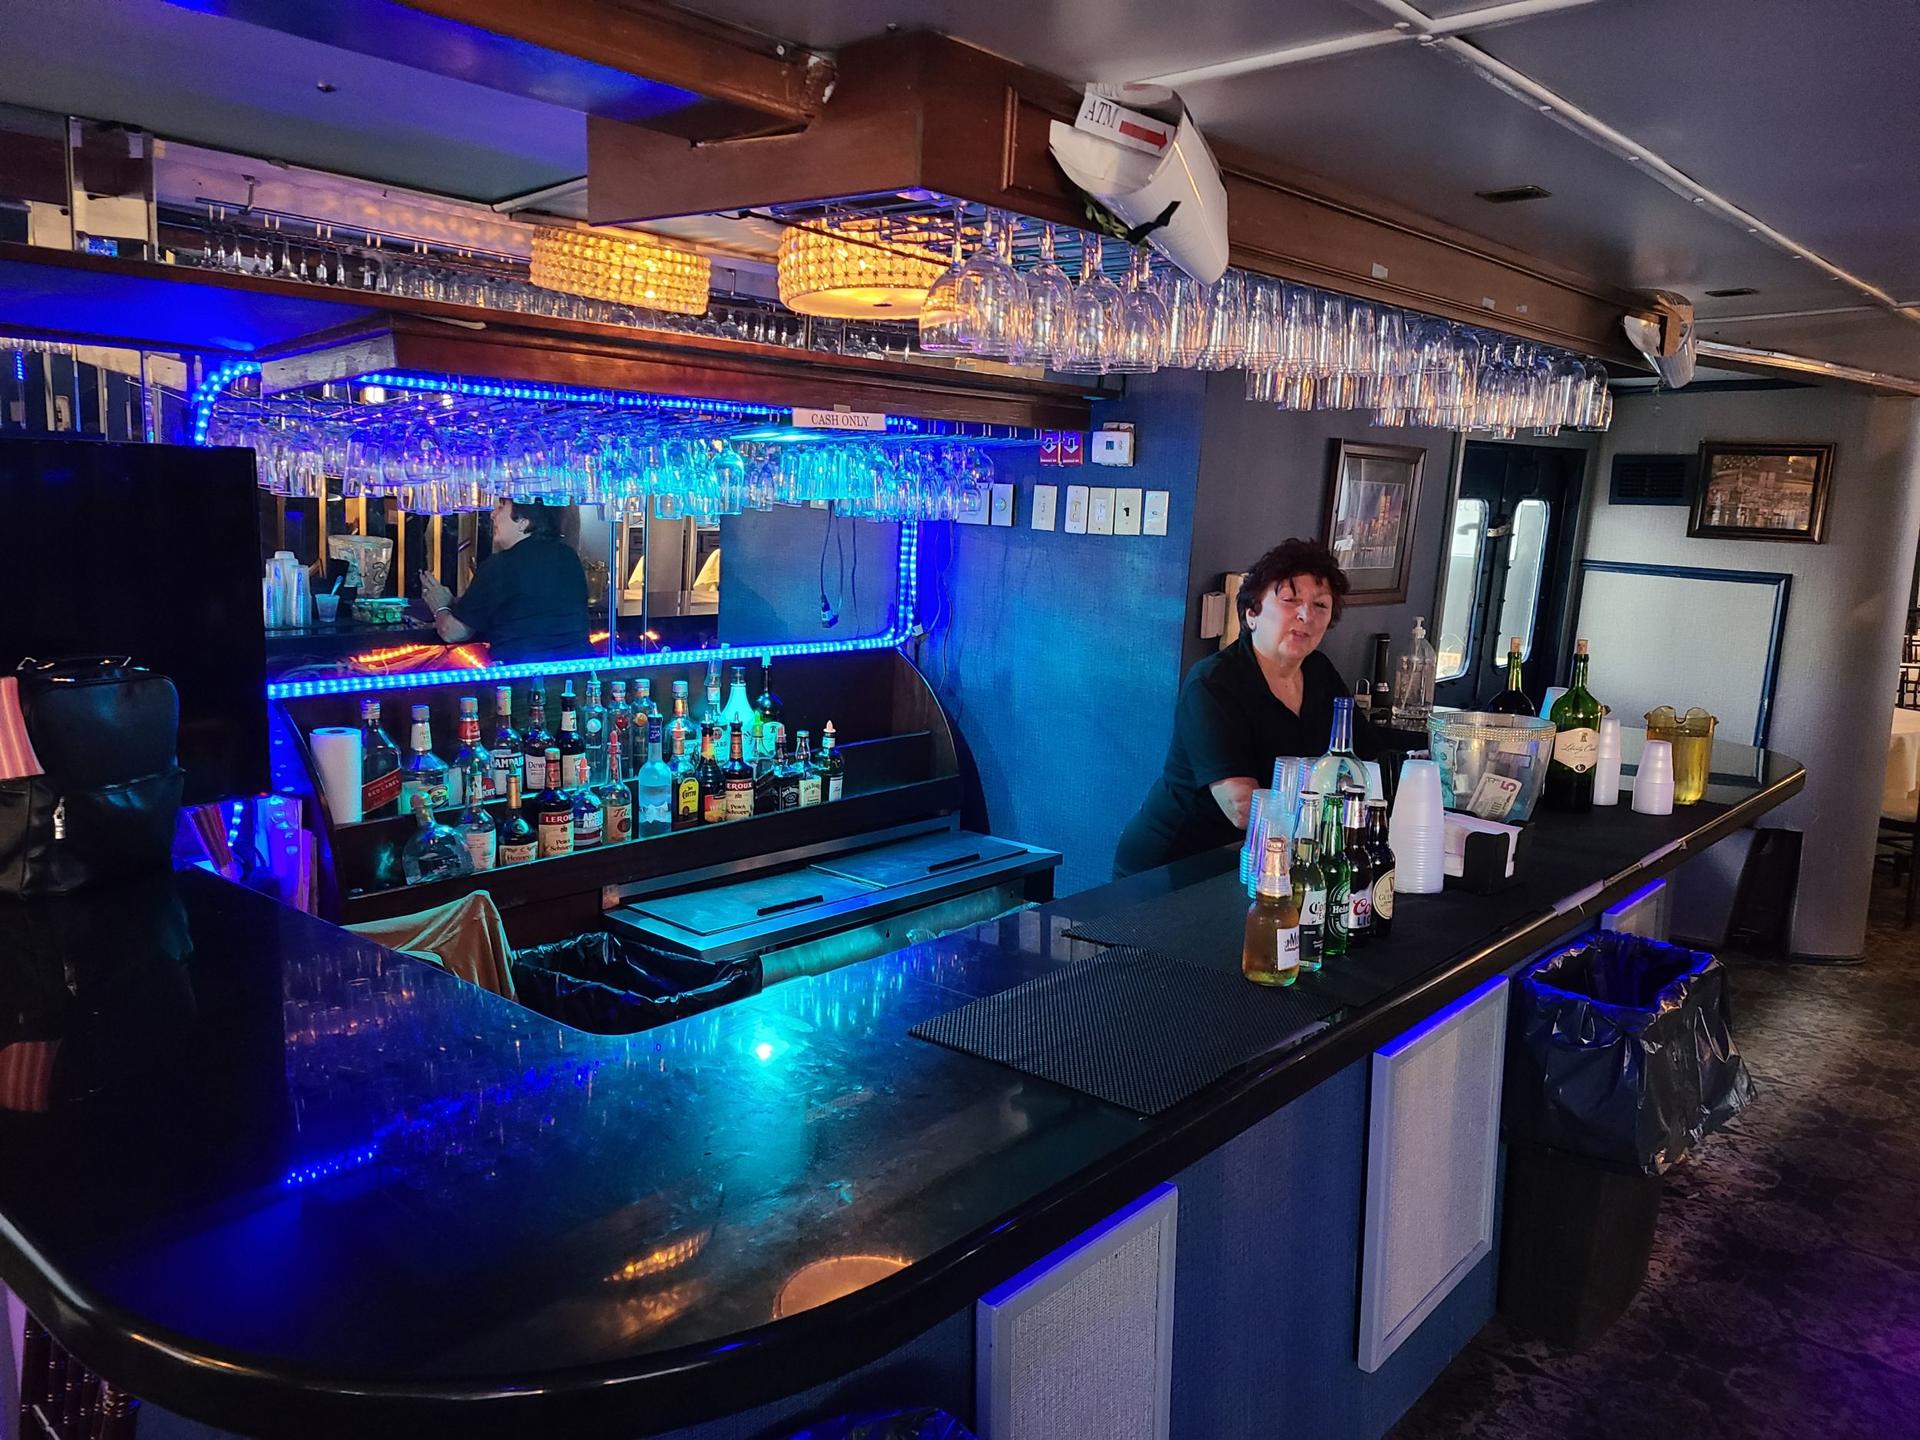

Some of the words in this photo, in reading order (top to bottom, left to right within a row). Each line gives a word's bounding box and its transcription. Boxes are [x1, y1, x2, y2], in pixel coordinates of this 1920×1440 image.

[1084, 99, 1120, 128] ATM
[811, 413, 839, 426] CASH
[841, 415, 869, 427] ONLY
[381, 778, 400, 791] LABEL
[1500, 780, 1517, 792] 5
